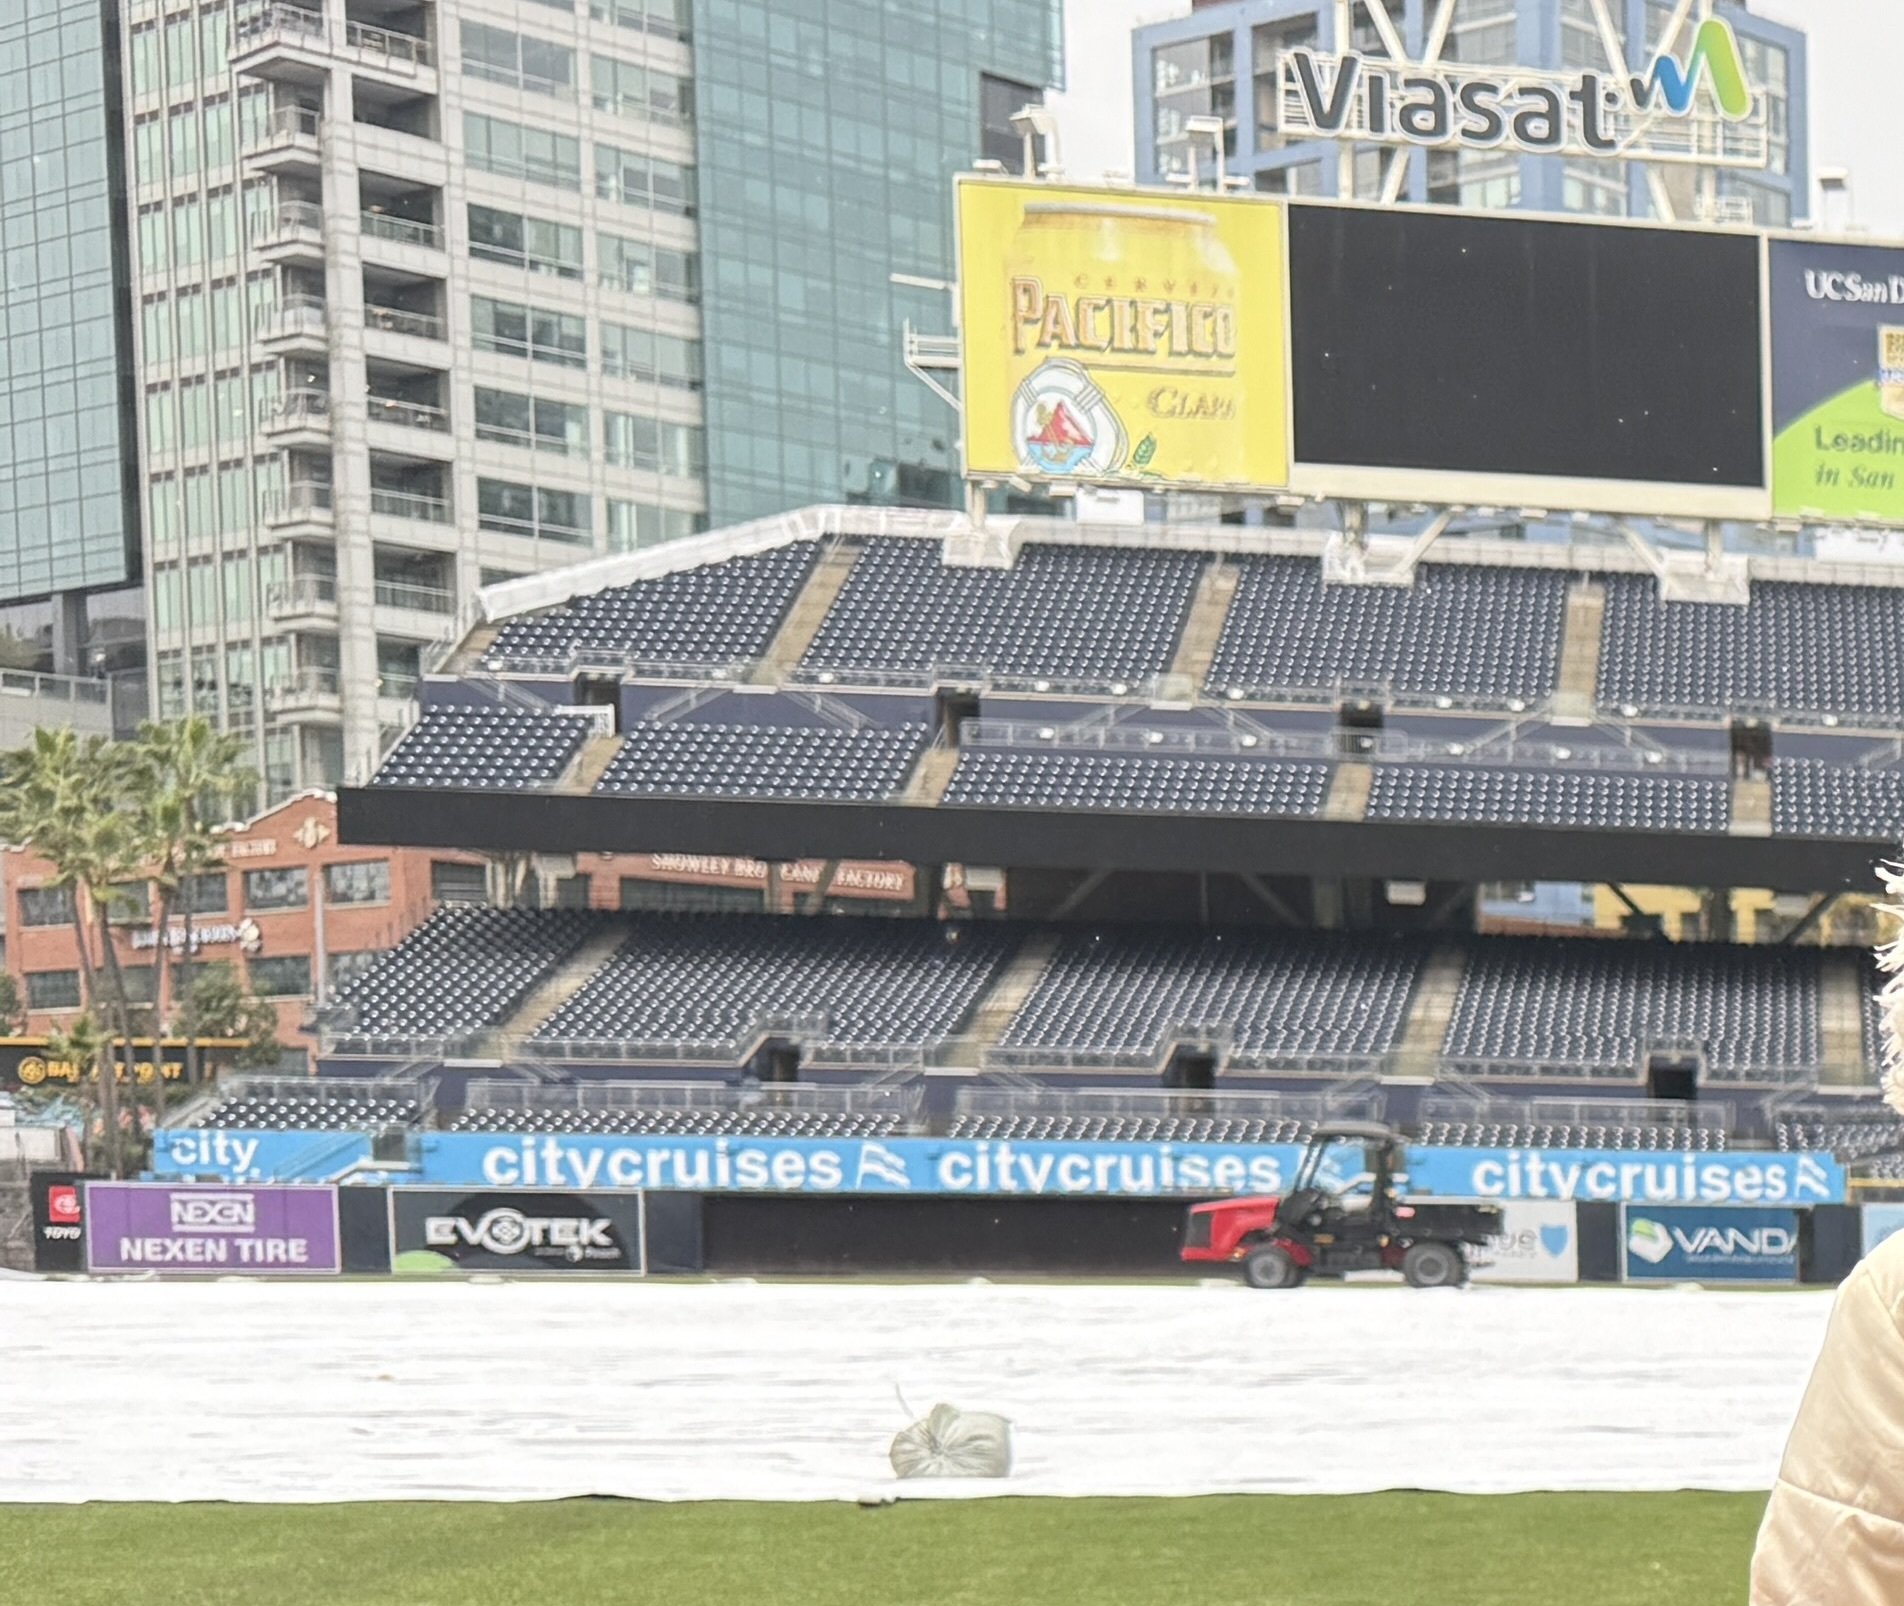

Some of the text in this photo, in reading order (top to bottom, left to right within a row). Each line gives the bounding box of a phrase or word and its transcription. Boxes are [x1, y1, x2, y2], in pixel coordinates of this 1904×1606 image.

[1293, 50, 1617, 149] Viasat
[1012, 276, 1236, 359] PACIFICO
[1816, 462, 1840, 486] in
[1849, 464, 1895, 490] San
[171, 1130, 260, 1173] city
[483, 1136, 843, 1189] citycruises
[937, 1141, 1281, 1193] citycruises
[1473, 1150, 1787, 1200] citycruises
[171, 1198, 255, 1227] NEXEN
[425, 1207, 613, 1255] EVOTEK
[120, 1237, 309, 1263] NEXEN TIRE
